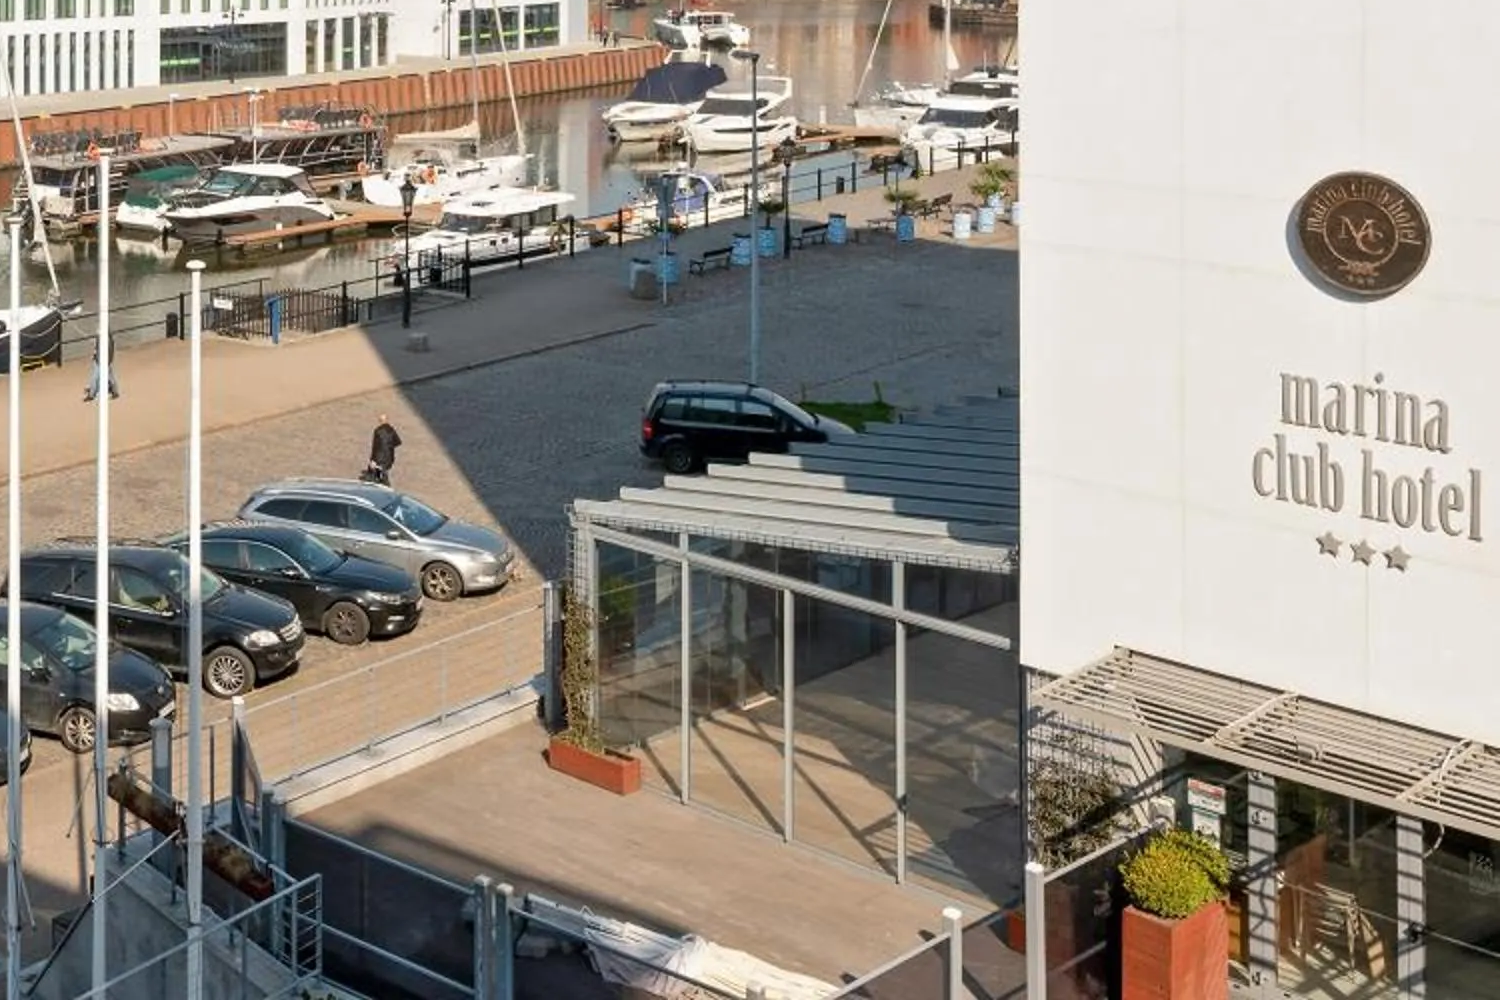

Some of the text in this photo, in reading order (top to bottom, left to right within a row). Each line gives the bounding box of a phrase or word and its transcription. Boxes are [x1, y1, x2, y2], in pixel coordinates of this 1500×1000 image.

[1280, 371, 1451, 454] marina
[1252, 434, 1483, 542] club hotel
